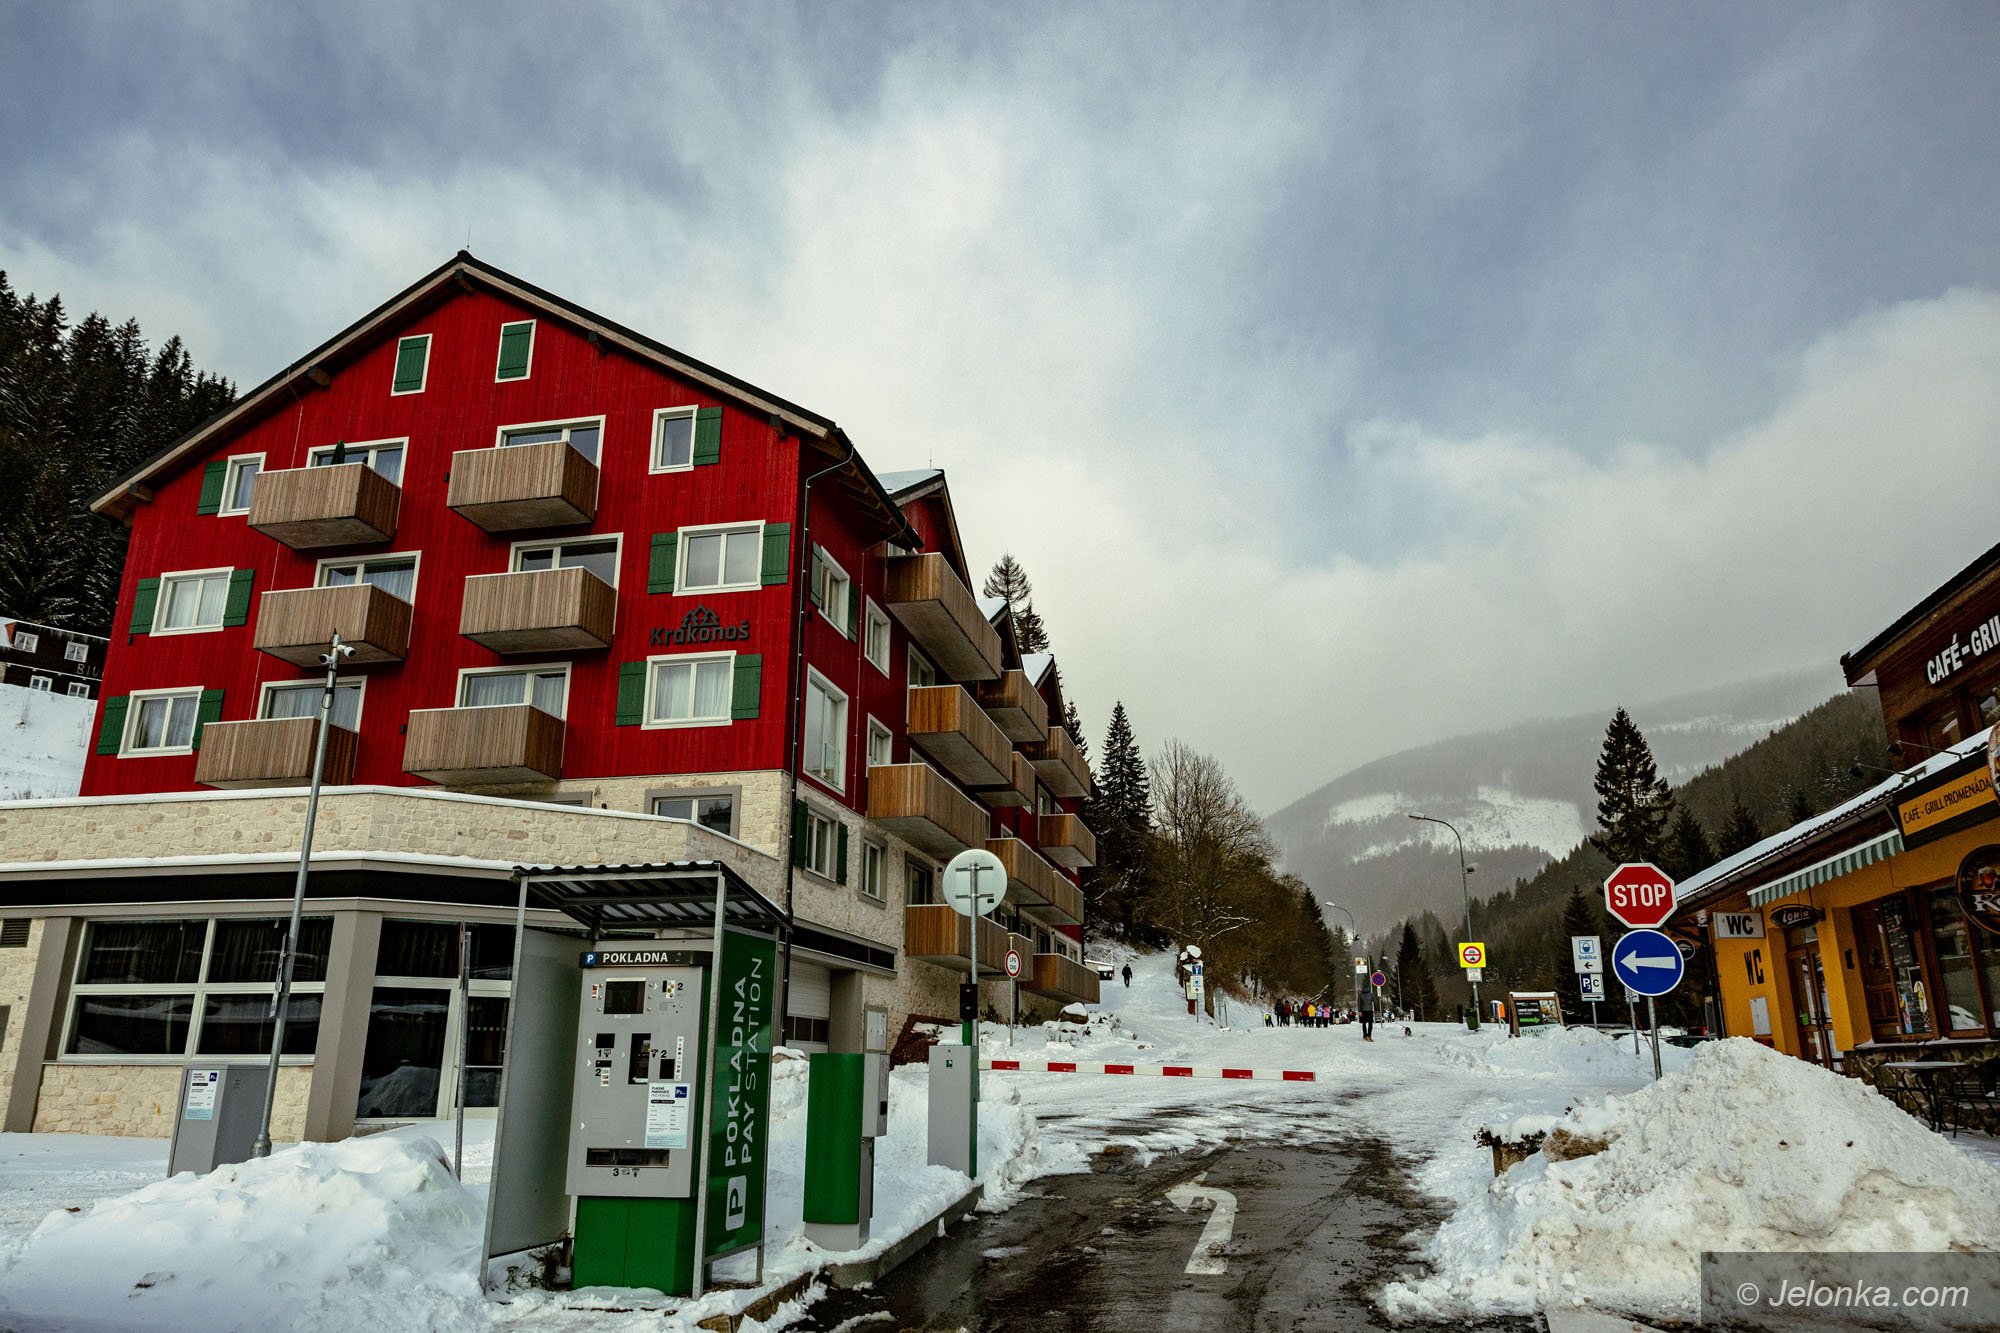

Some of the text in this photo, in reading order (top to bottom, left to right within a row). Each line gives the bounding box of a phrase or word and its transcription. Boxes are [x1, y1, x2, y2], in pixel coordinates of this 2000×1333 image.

[650, 619, 749, 647] Krakonoš
[1903, 805, 1921, 824] CAFÉ
[1924, 799, 1945, 816] GRILL
[1943, 777, 1992, 809] PROMENÁDA
[1613, 883, 1667, 907] STOP
[1726, 915, 1754, 935] WC
[586, 954, 594, 963] P
[602, 952, 669, 963] POKLADNA
[1743, 948, 1765, 986] WC
[677, 983, 684, 991] 2
[1592, 979, 1600, 988] C
[661, 1050, 667, 1058] 2
[741, 957, 763, 1165] PAY STATION
[595, 1069, 601, 1077] 2
[724, 976, 747, 1168] POKLADNA
[613, 1168, 620, 1177] 3
[728, 1187, 744, 1217] P
